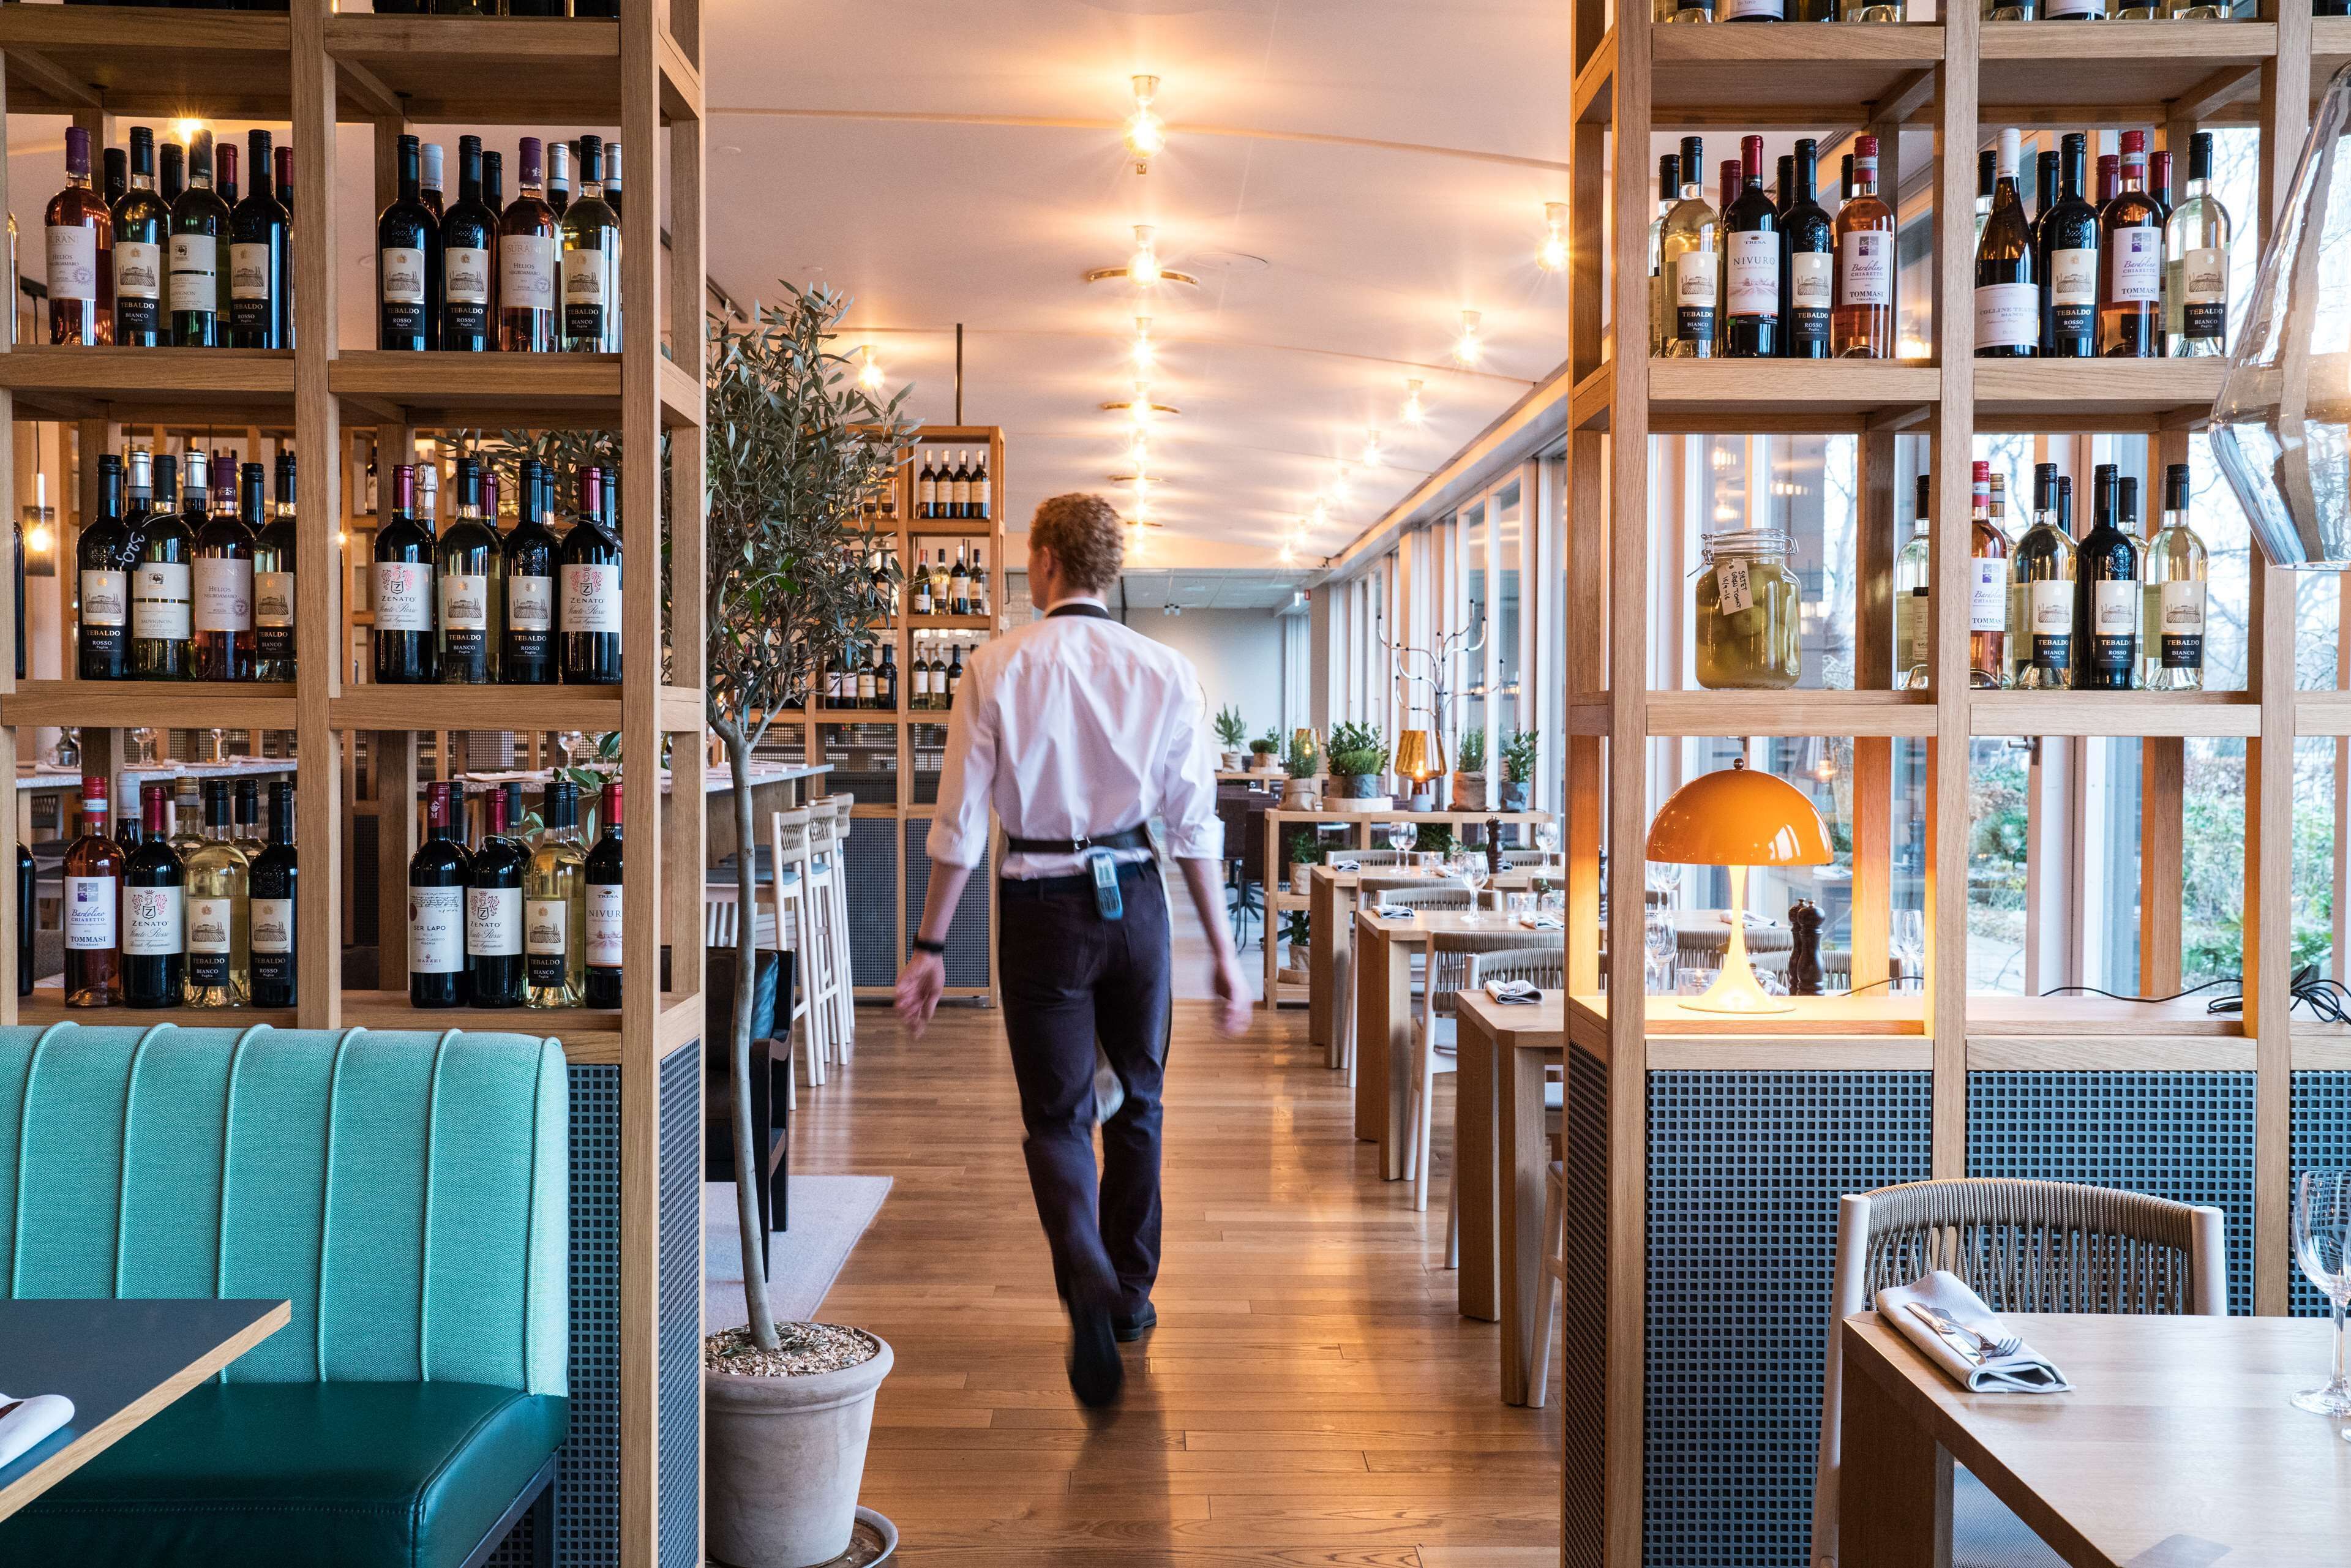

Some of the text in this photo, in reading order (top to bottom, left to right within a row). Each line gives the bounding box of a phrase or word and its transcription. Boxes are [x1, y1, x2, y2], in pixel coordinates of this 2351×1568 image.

[1733, 257, 1775, 266] NIVURO
[1851, 260, 1883, 272] Bardolino
[1979, 307, 2012, 316] COLLINE
[71, 906, 105, 917] Bardolino
[148, 927, 169, 937] Rosso
[483, 928, 502, 939] Rosso
